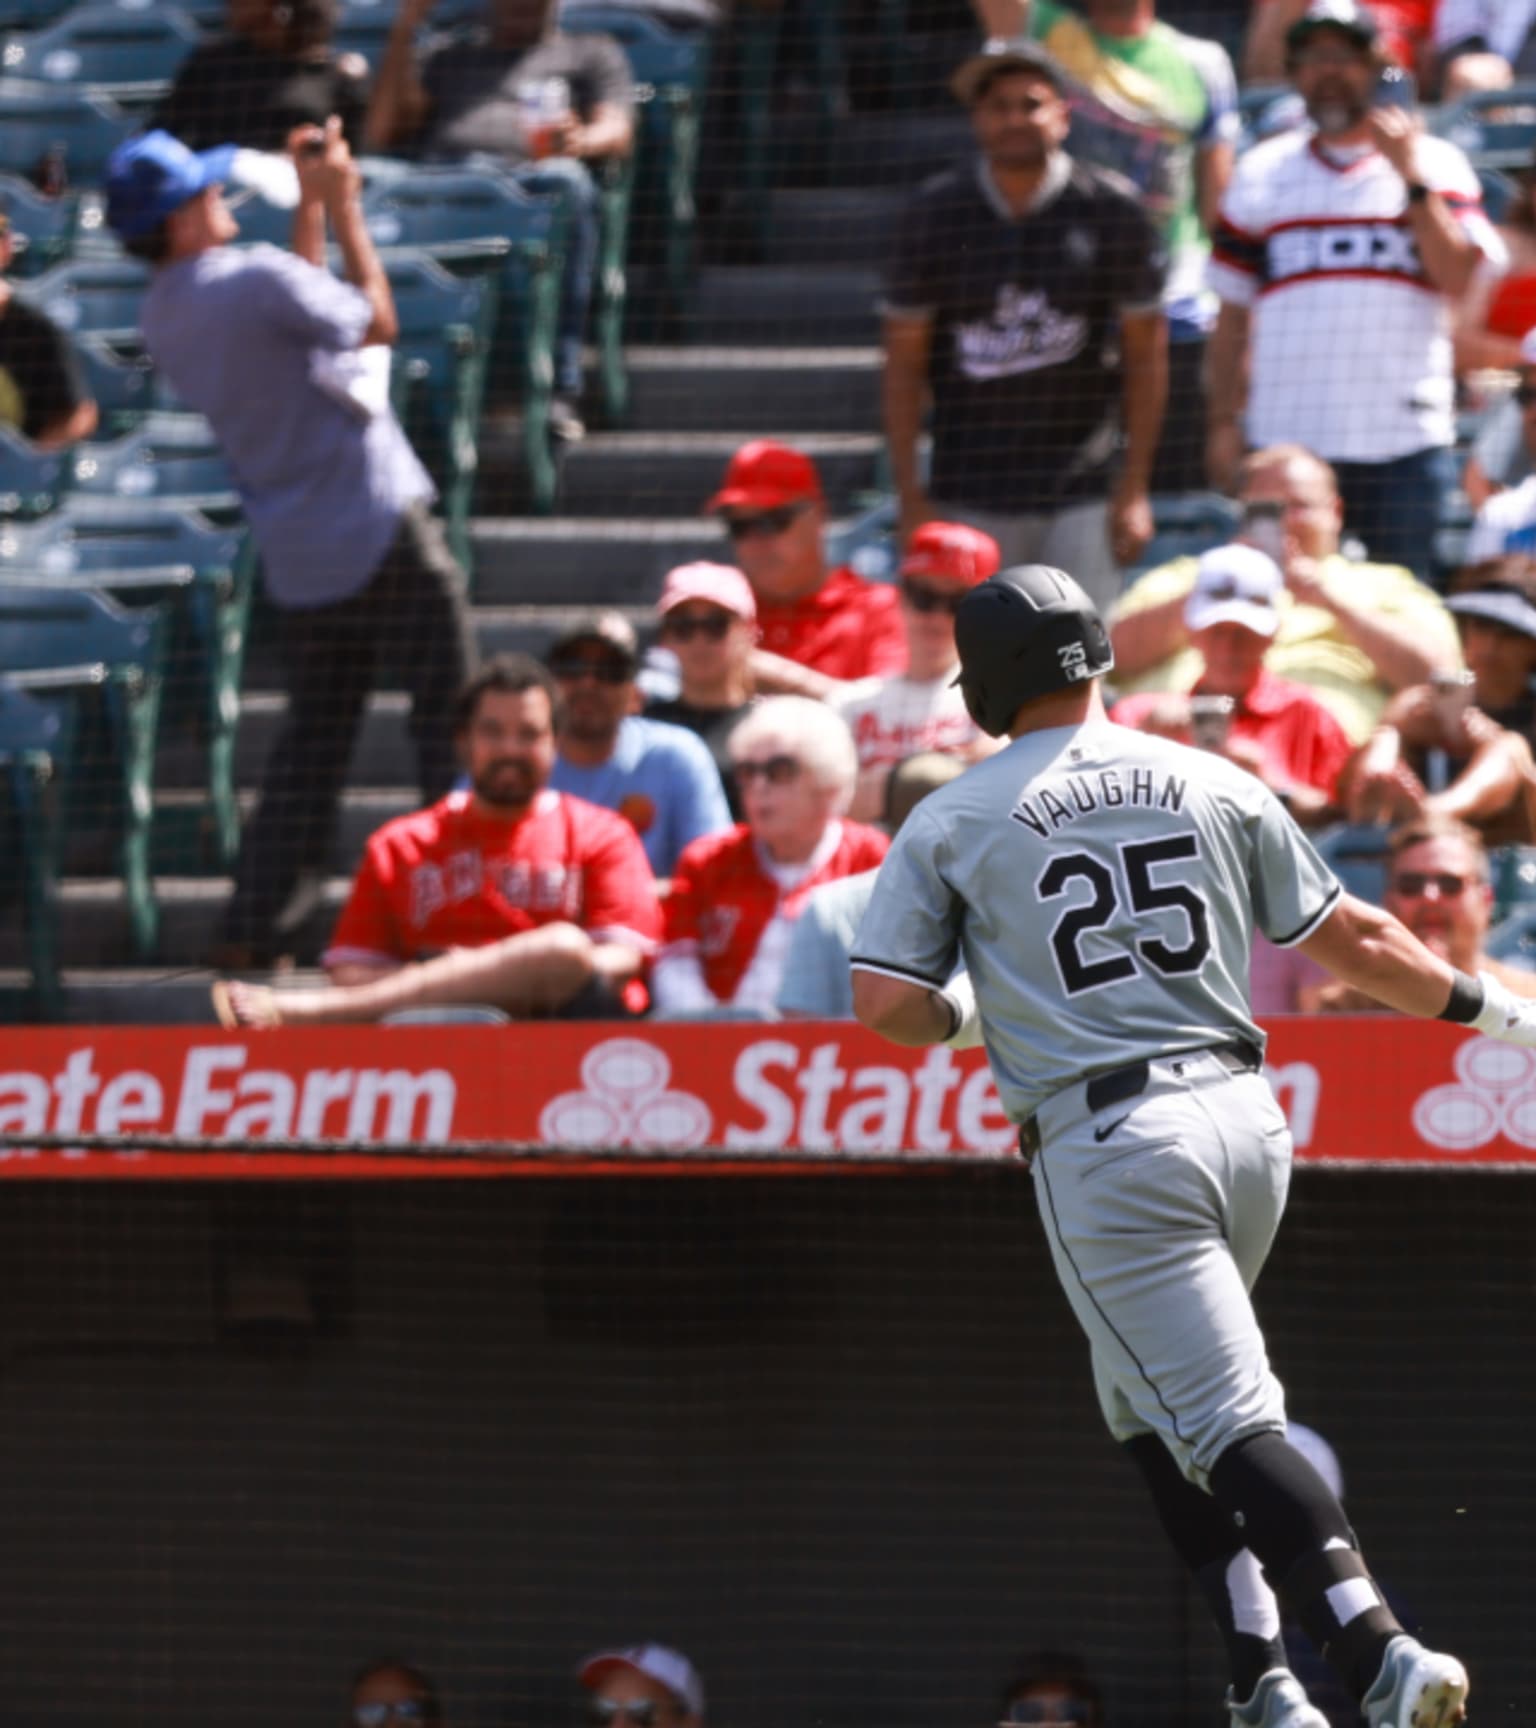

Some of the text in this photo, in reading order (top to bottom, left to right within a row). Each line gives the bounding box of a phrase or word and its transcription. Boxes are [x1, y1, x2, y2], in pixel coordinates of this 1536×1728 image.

[1057, 641, 1086, 669] 25
[1009, 766, 1187, 840] VAUGHN
[1034, 830, 1212, 999] 25
